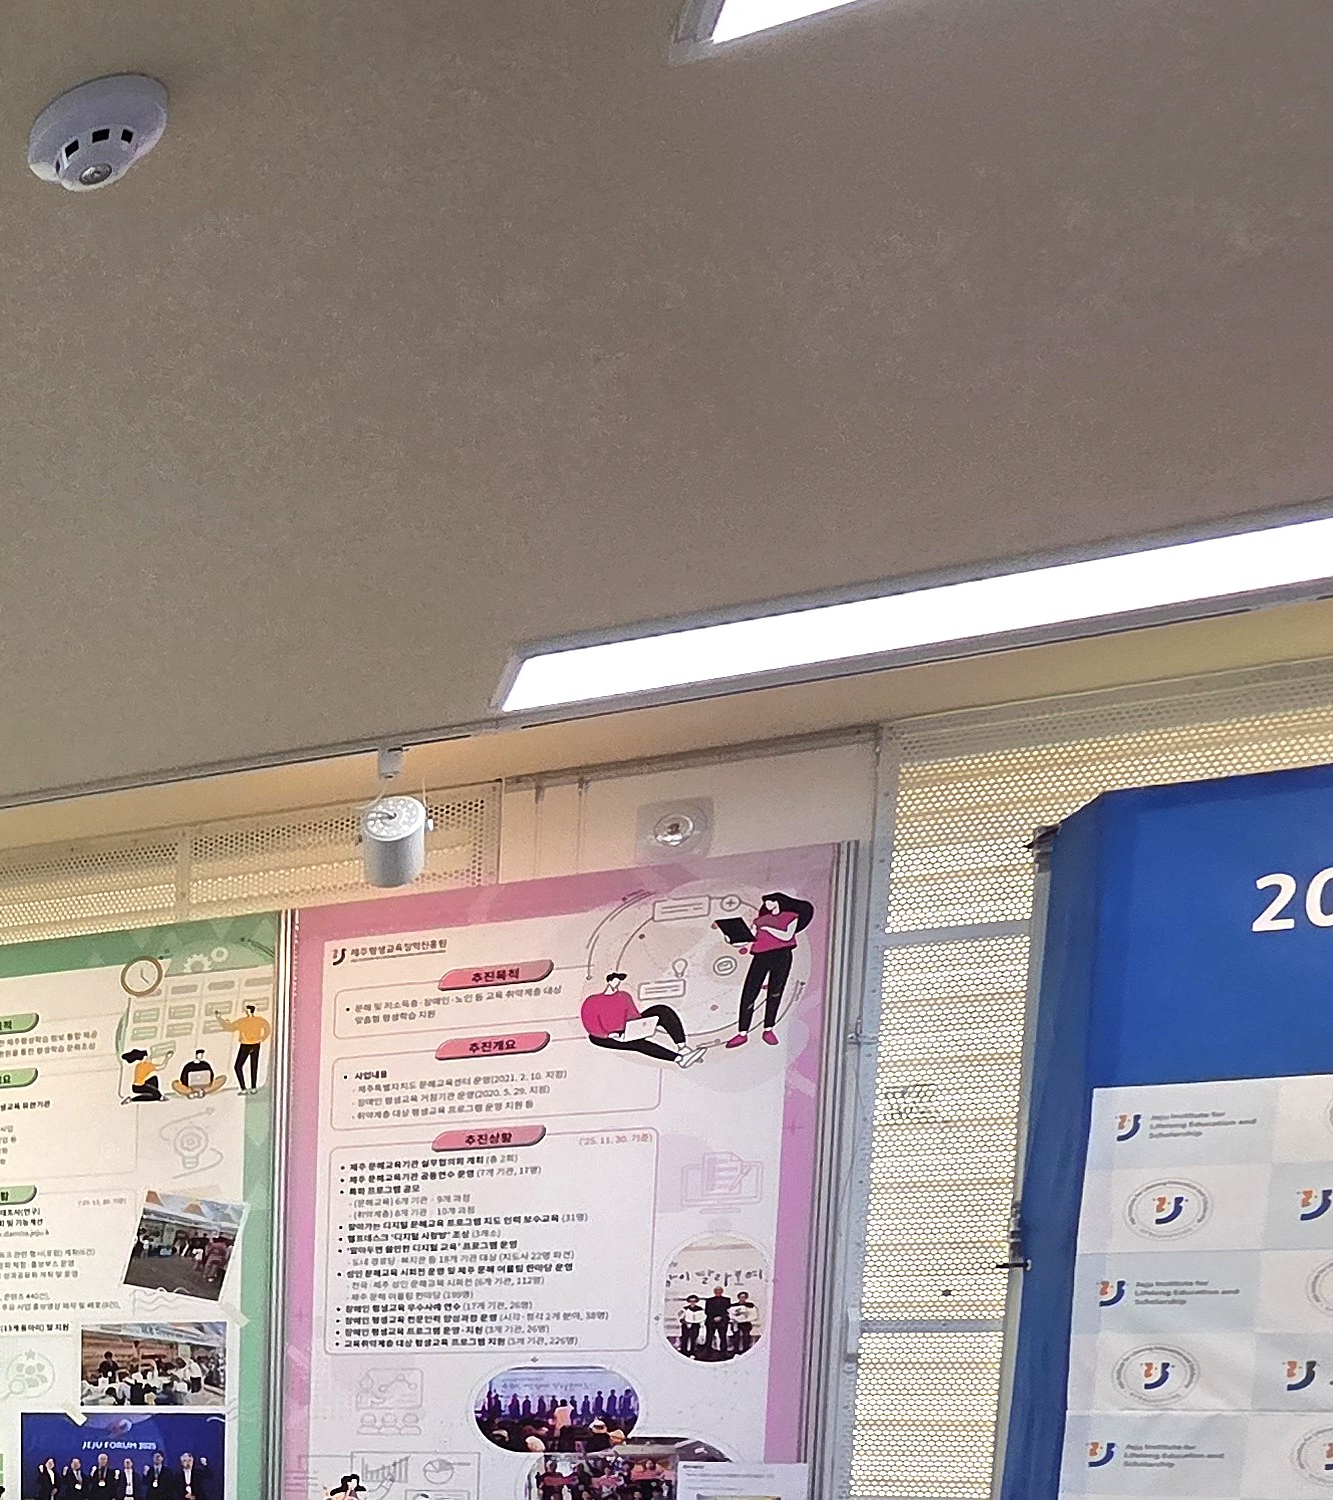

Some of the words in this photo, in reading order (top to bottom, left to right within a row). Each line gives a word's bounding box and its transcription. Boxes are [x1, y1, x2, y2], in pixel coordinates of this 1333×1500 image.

[1251, 866, 1333, 932] 20
[471, 967, 521, 984] 추진목적
[468, 1039, 517, 1054] 추진개요
[464, 1131, 513, 1147] 추진상황
